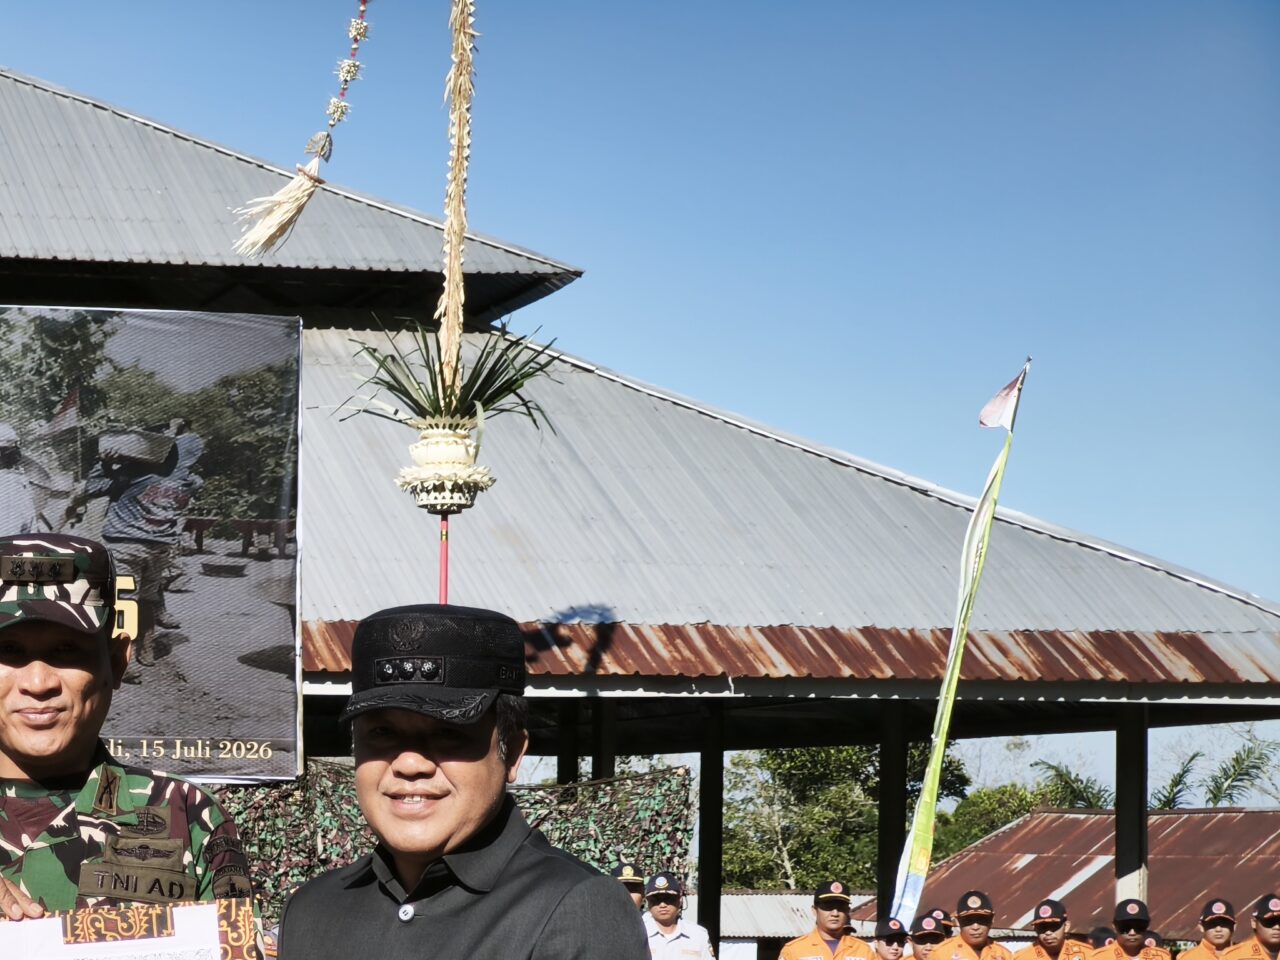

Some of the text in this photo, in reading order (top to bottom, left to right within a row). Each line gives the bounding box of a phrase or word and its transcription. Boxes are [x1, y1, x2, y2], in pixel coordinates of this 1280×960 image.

[140, 740, 165, 757] 15
[172, 739, 210, 759] Juli
[220, 741, 272, 759] 2026
[94, 870, 184, 899] TNI AD
